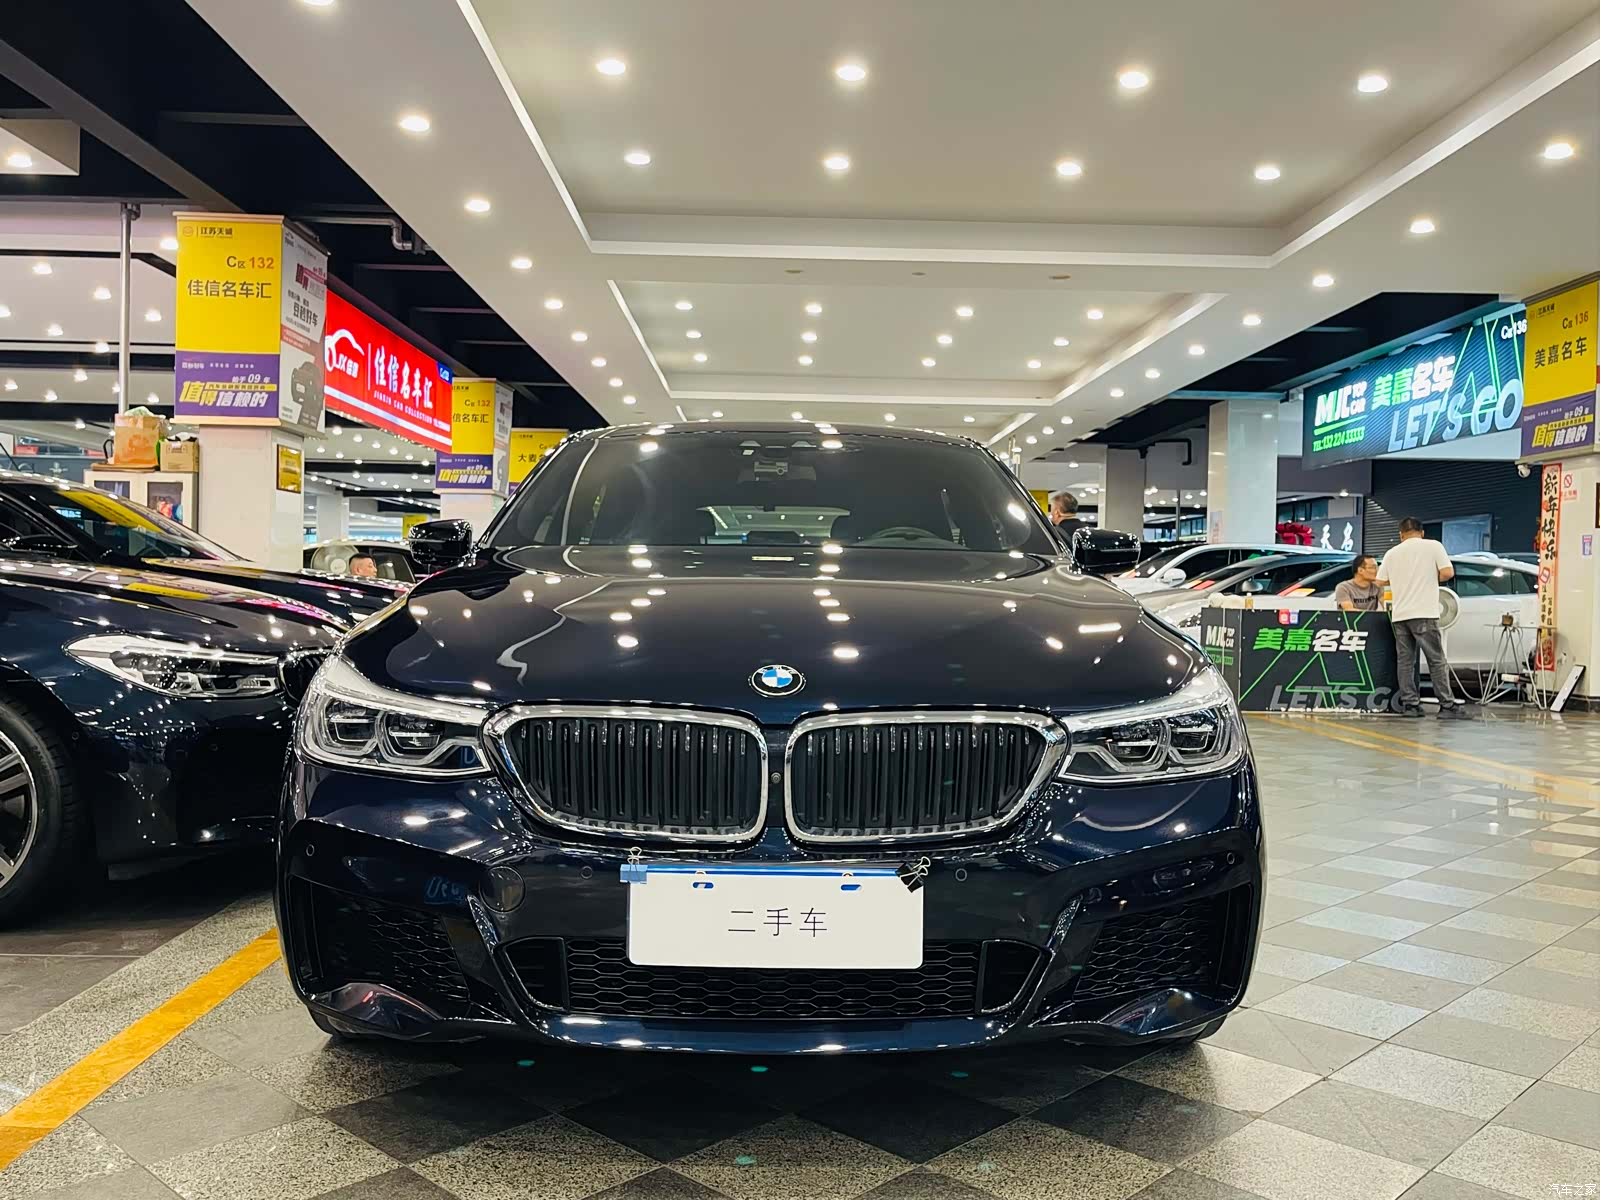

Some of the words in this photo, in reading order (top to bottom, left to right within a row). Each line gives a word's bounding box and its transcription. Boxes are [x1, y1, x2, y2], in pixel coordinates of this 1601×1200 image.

[249, 256, 275, 270] 132
[187, 279, 272, 299] 佳信名车汇
[1575, 310, 1589, 326] 136
[1534, 336, 1588, 369] 美嘉名车
[247, 373, 262, 383] 09
[374, 345, 433, 409] 佳信名车汇
[1371, 355, 1456, 411] 美嘉名车
[178, 380, 268, 408] 值得信赖的
[1387, 392, 1466, 452] LET'S
[1471, 379, 1524, 436] GO
[1531, 423, 1588, 449] 值得信赖的
[1542, 473, 1559, 561] 新年快乐
[1252, 628, 1369, 652] 美嘉名车
[1269, 685, 1365, 712] LET'S
[728, 906, 828, 937] 二手车
